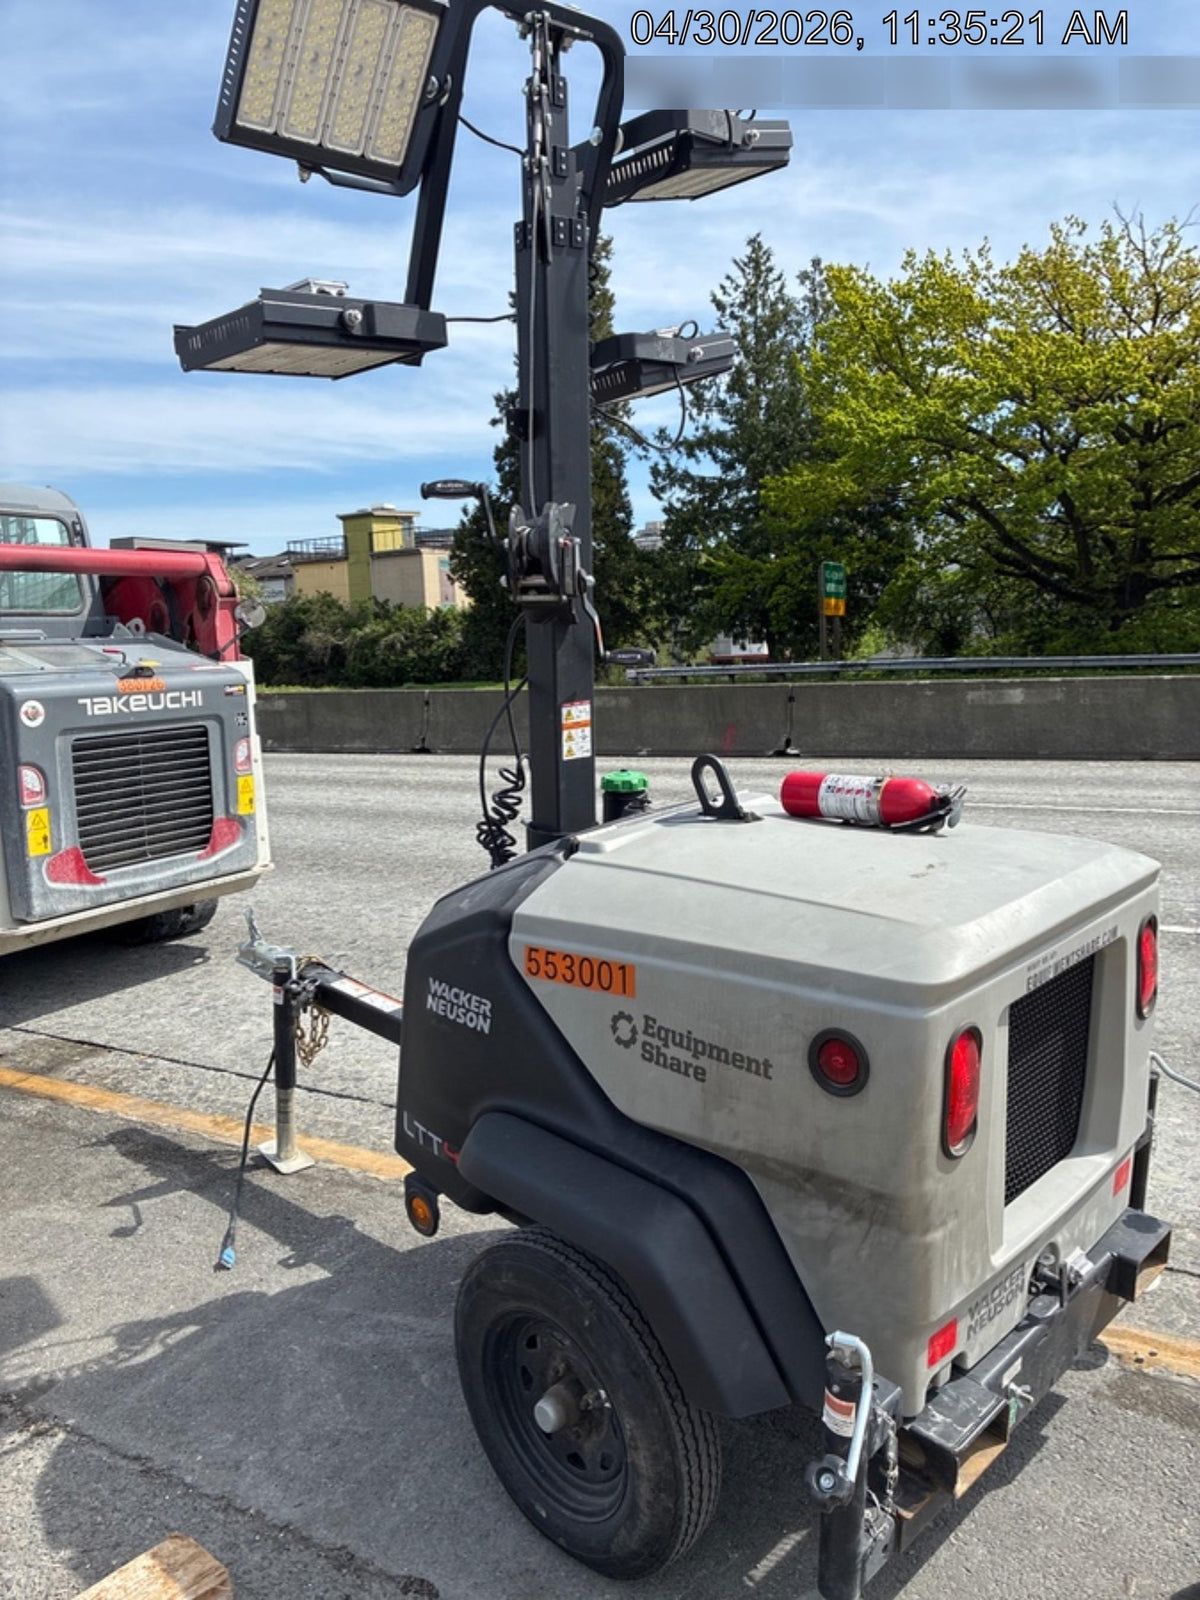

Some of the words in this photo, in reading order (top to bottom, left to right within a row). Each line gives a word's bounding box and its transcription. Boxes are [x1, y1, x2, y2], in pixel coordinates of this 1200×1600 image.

[526, 946, 629, 996] 553001
[426, 993, 491, 1035] NEUSON
[428, 976, 492, 1018] WACKER
[640, 1041, 707, 1084] Share
[642, 1014, 774, 1081] Equipment
[966, 1276, 1025, 1341] NEUSON
